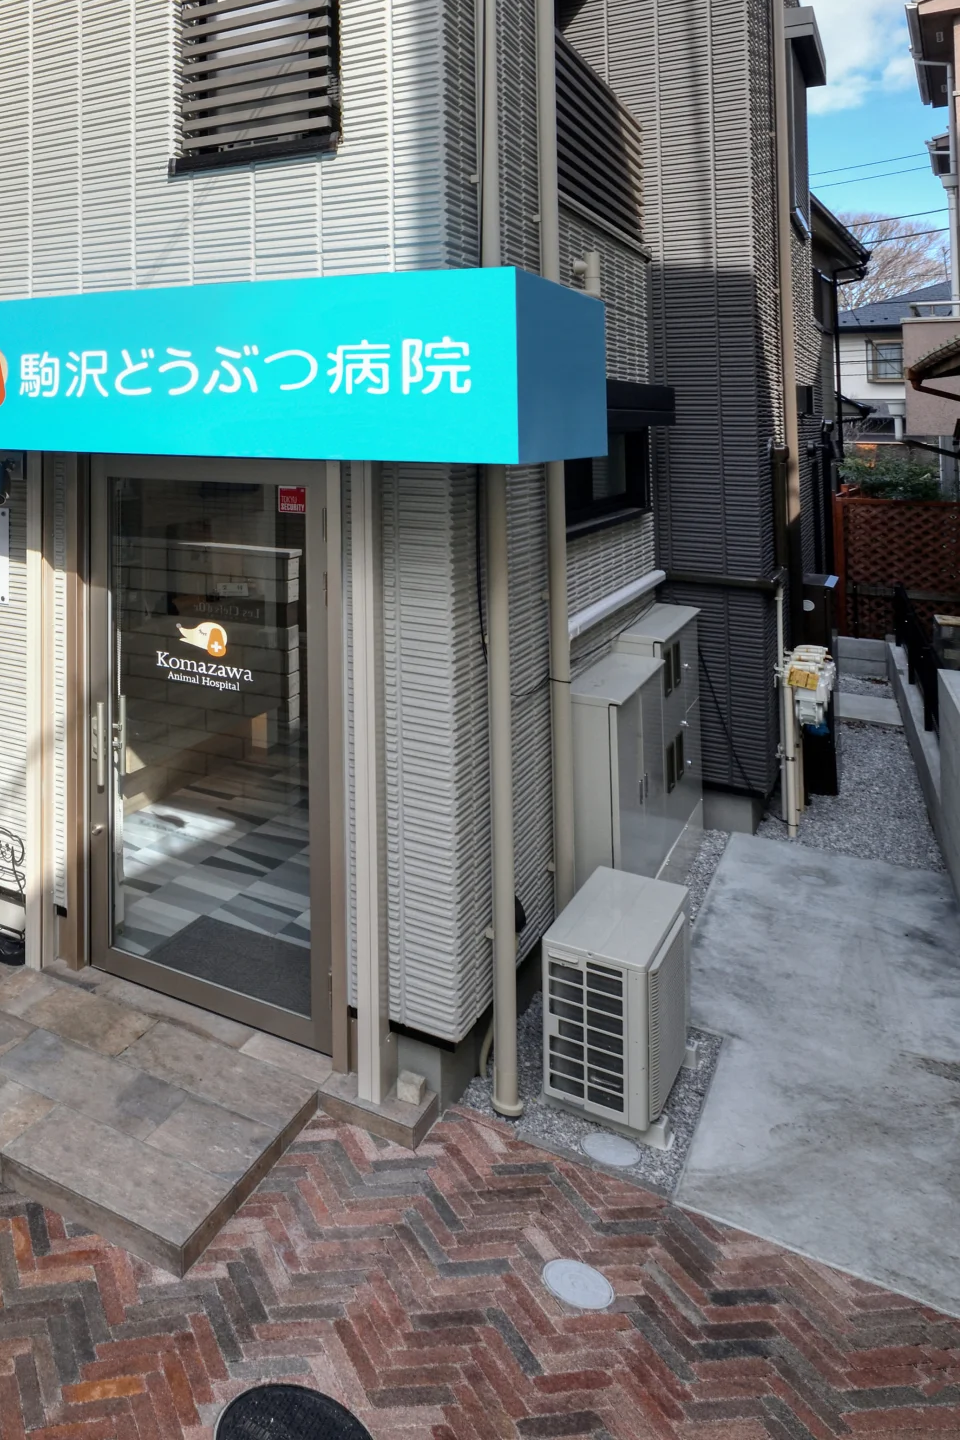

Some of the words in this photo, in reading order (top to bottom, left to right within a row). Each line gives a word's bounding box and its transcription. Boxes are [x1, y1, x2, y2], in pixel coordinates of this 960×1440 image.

[19, 336, 472, 399] 駒沢どうぶつ病院
[281, 503, 304, 511] SECURITY
[156, 650, 253, 682] Komazawa
[167, 671, 199, 685] Animal
[202, 677, 240, 691] Hospital
